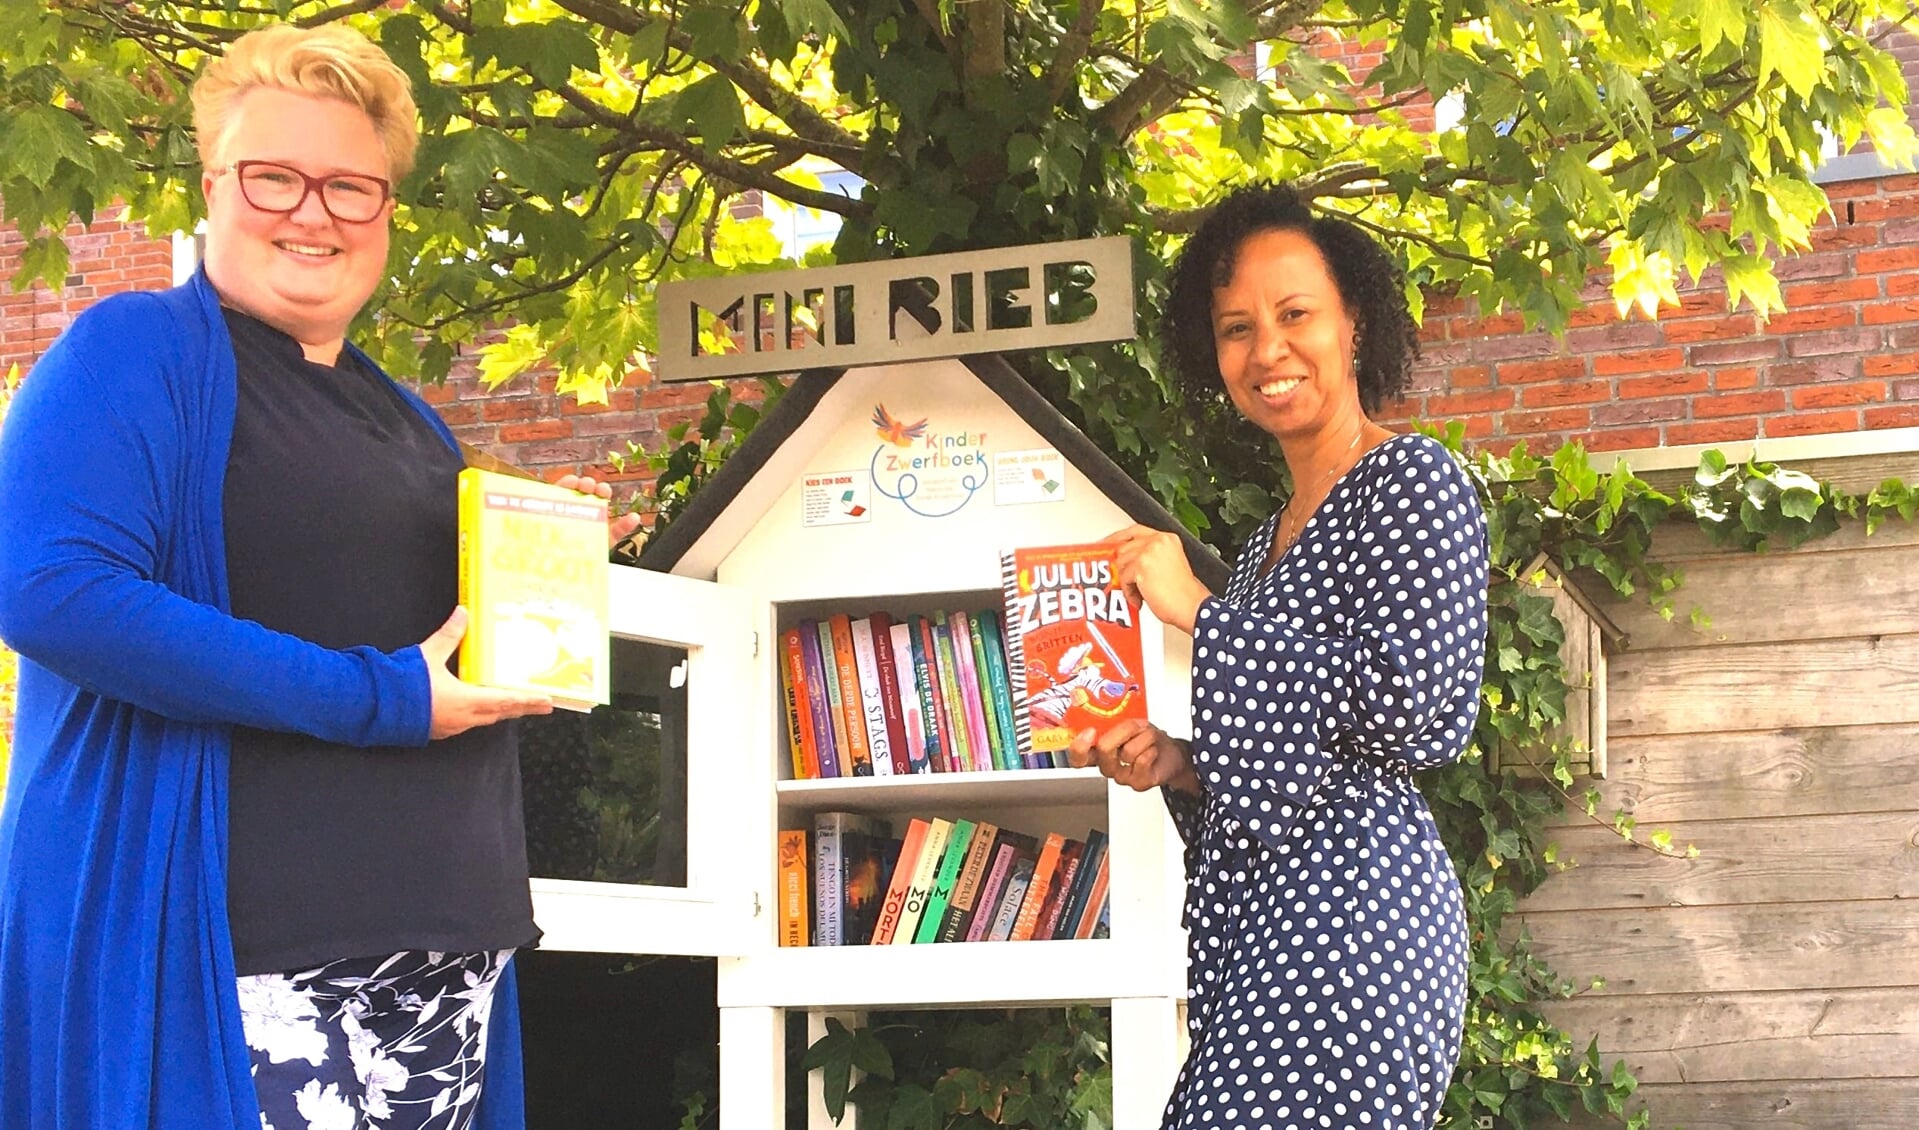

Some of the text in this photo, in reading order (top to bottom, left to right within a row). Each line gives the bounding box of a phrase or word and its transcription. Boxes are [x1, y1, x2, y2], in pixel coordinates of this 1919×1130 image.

[691, 260, 1098, 357] MINI BIEB
[926, 432, 987, 449] Kinder
[886, 450, 986, 471] Zwerfboek
[1031, 560, 1111, 591] JULIUS
[1018, 588, 1132, 633] ZEBRA
[1036, 634, 1083, 652] BRITTEN
[841, 665, 850, 677] DE
[920, 663, 931, 689] ELVIS
[843, 679, 855, 708] DERDE
[925, 691, 933, 704] DE
[849, 709, 862, 749] PERSOON
[927, 705, 938, 736] DRAAK
[972, 841, 987, 867] PETER
[828, 862, 836, 894] TENGO
[1035, 879, 1048, 899] THE
[829, 896, 836, 908] EN
[958, 877, 975, 907] ZWAAN
[949, 909, 963, 928] HET
[998, 885, 1024, 928] Solace
[1011, 873, 1041, 941] BUTTERFLIE
[1025, 902, 1040, 929] FALL
